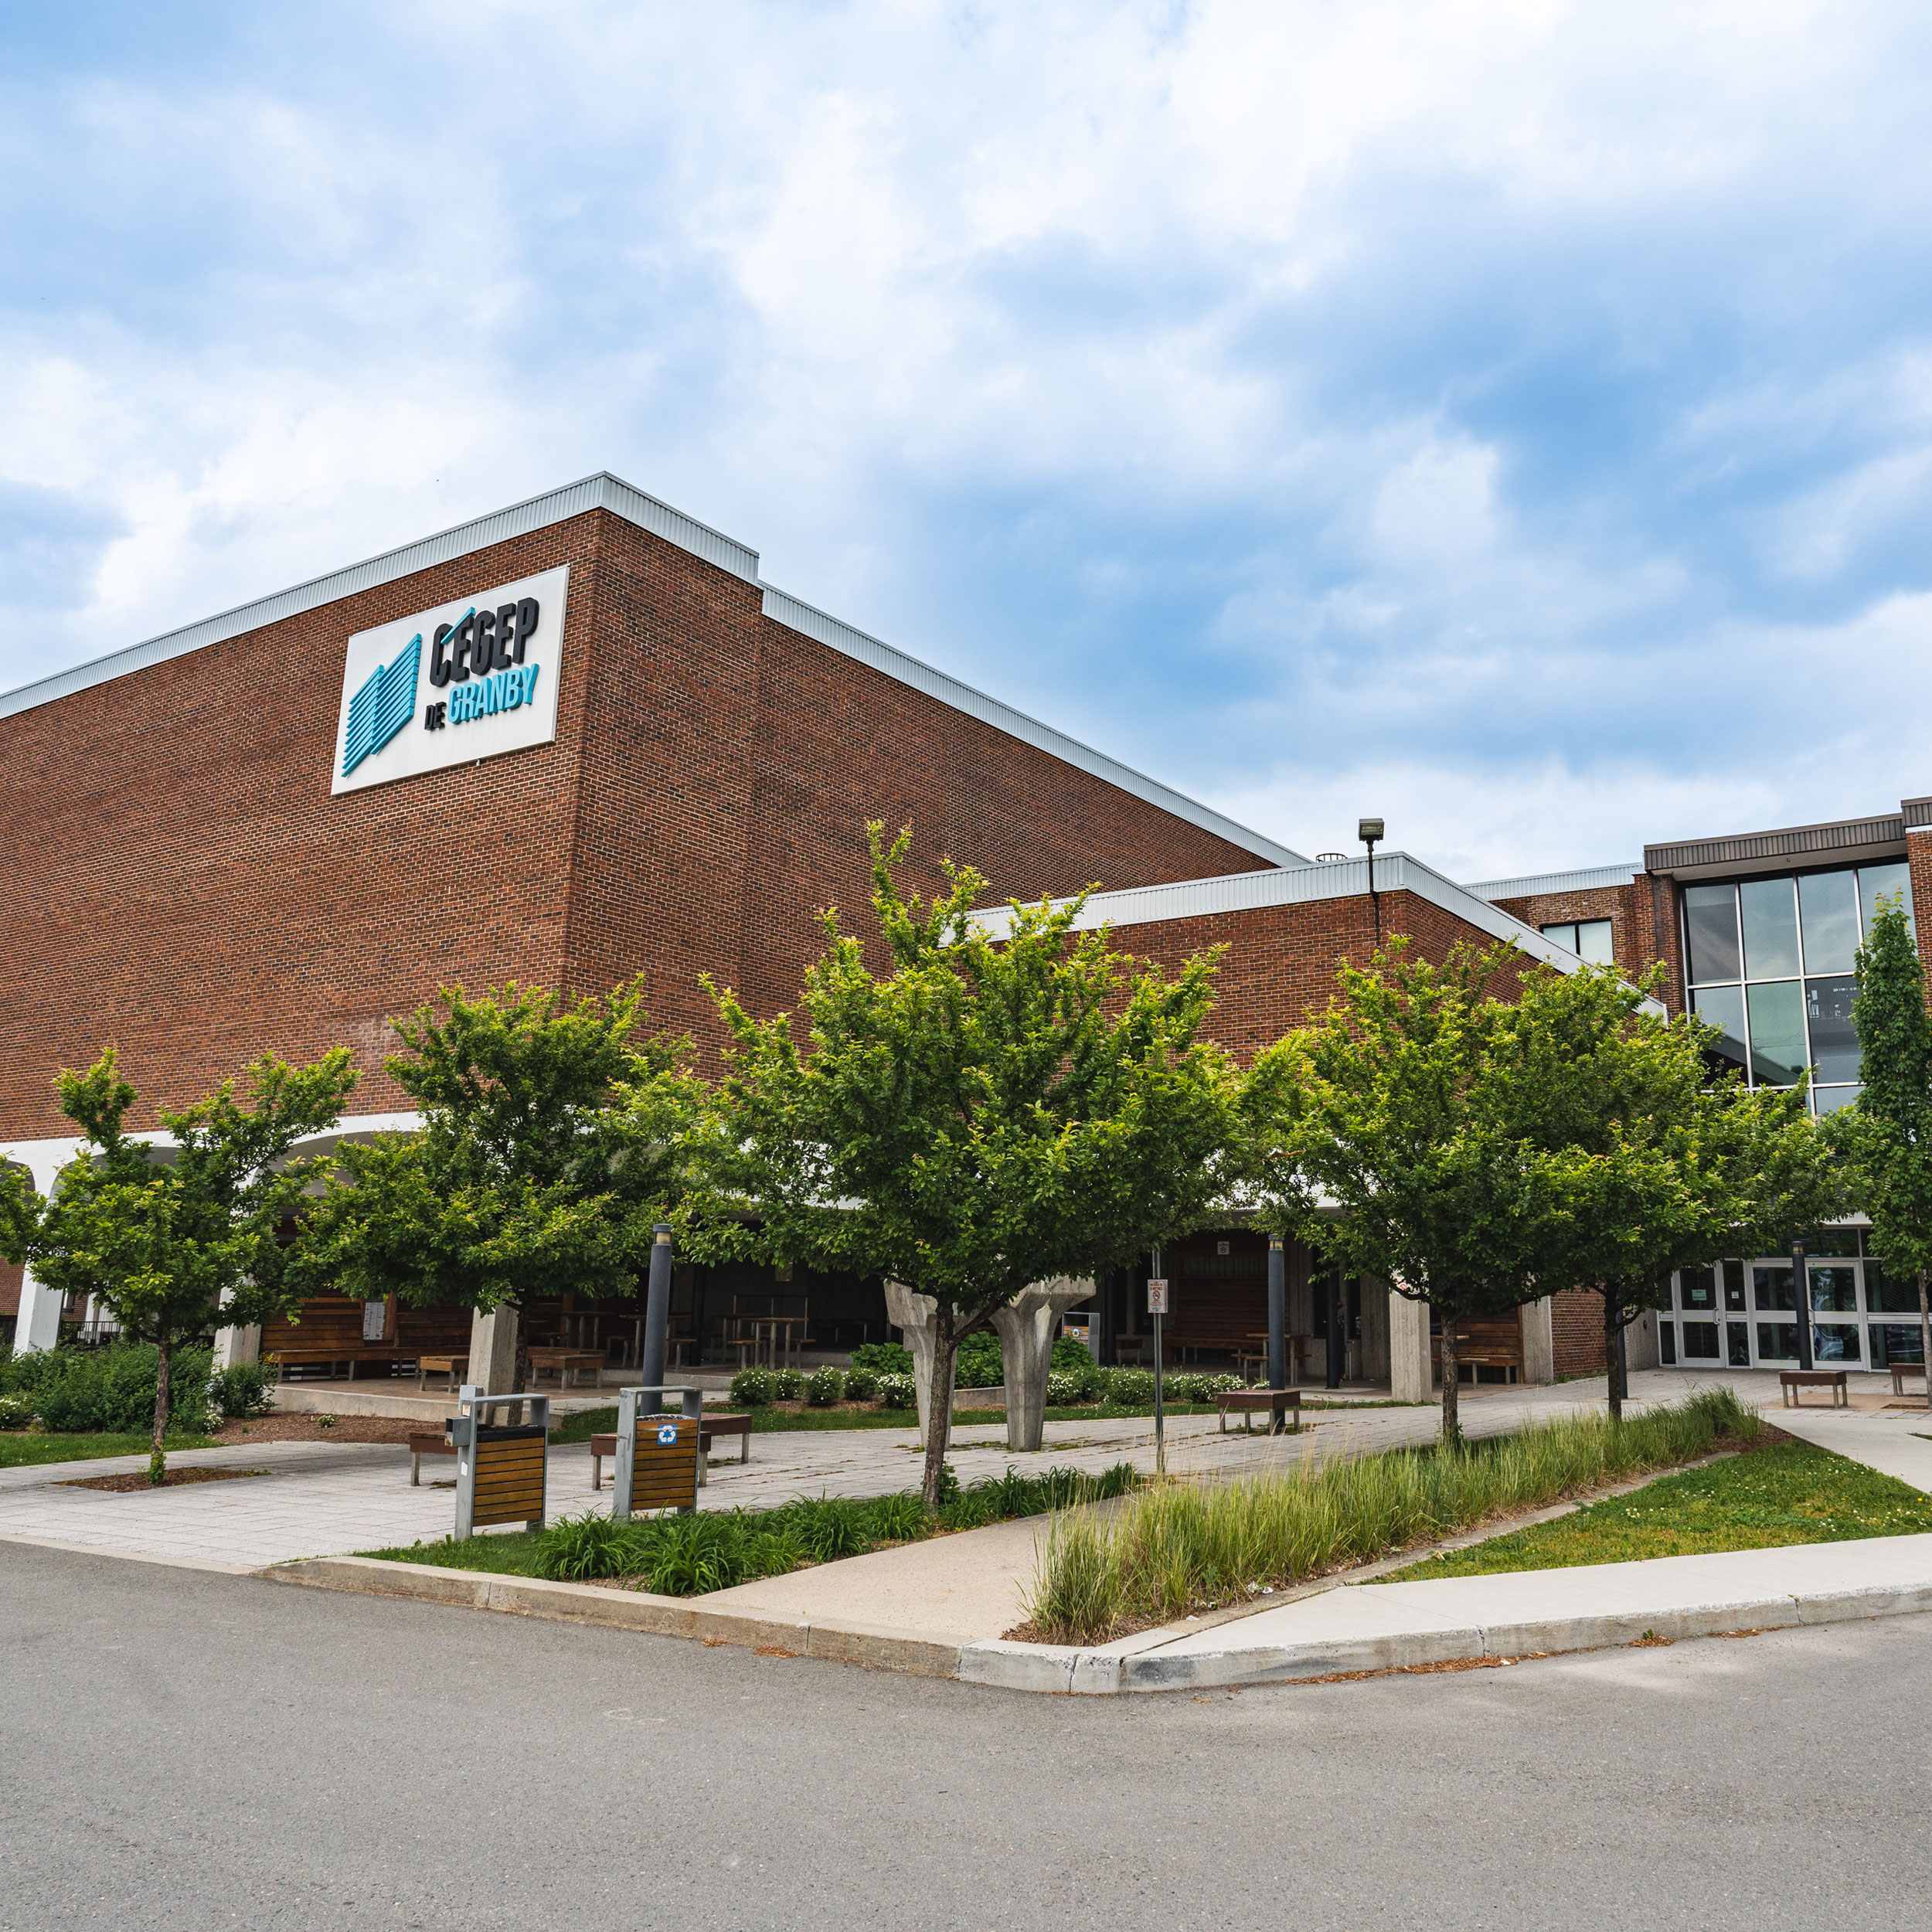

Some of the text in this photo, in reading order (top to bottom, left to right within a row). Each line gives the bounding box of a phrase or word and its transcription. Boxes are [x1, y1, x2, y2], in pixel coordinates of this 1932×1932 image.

[430, 597, 539, 687] CÉGEP
[424, 663, 539, 730] DE GRANBY
